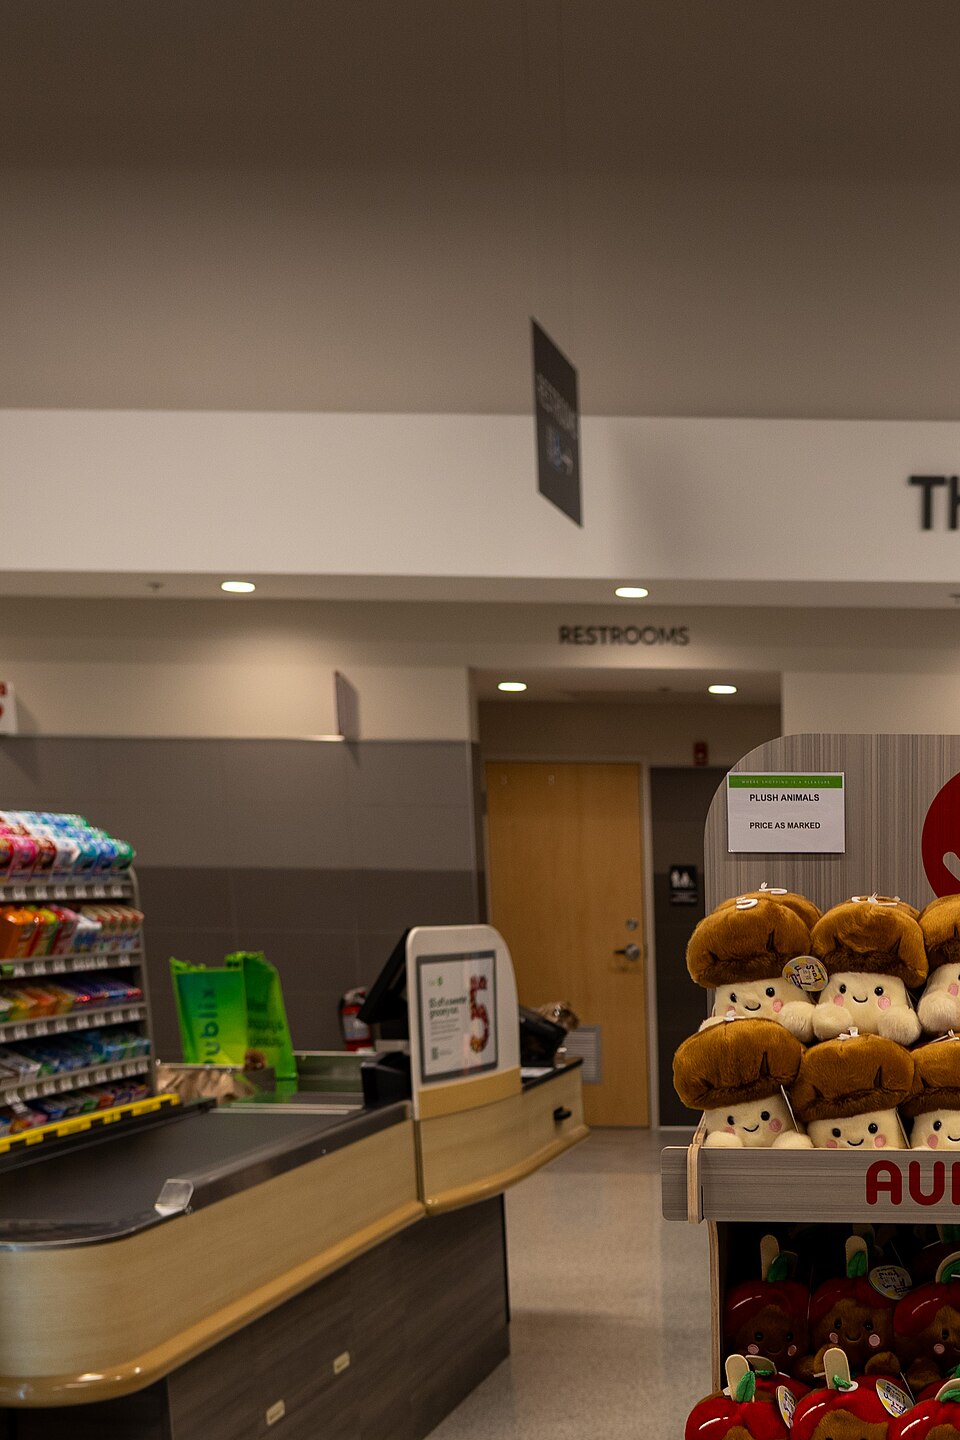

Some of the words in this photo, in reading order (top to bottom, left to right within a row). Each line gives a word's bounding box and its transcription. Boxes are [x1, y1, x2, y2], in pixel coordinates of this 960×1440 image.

[559, 625, 690, 646] RESTROOMS
[749, 794, 779, 802] PLUSH
[781, 794, 820, 802] ANIMALS
[198, 987, 220, 1064] ublix
